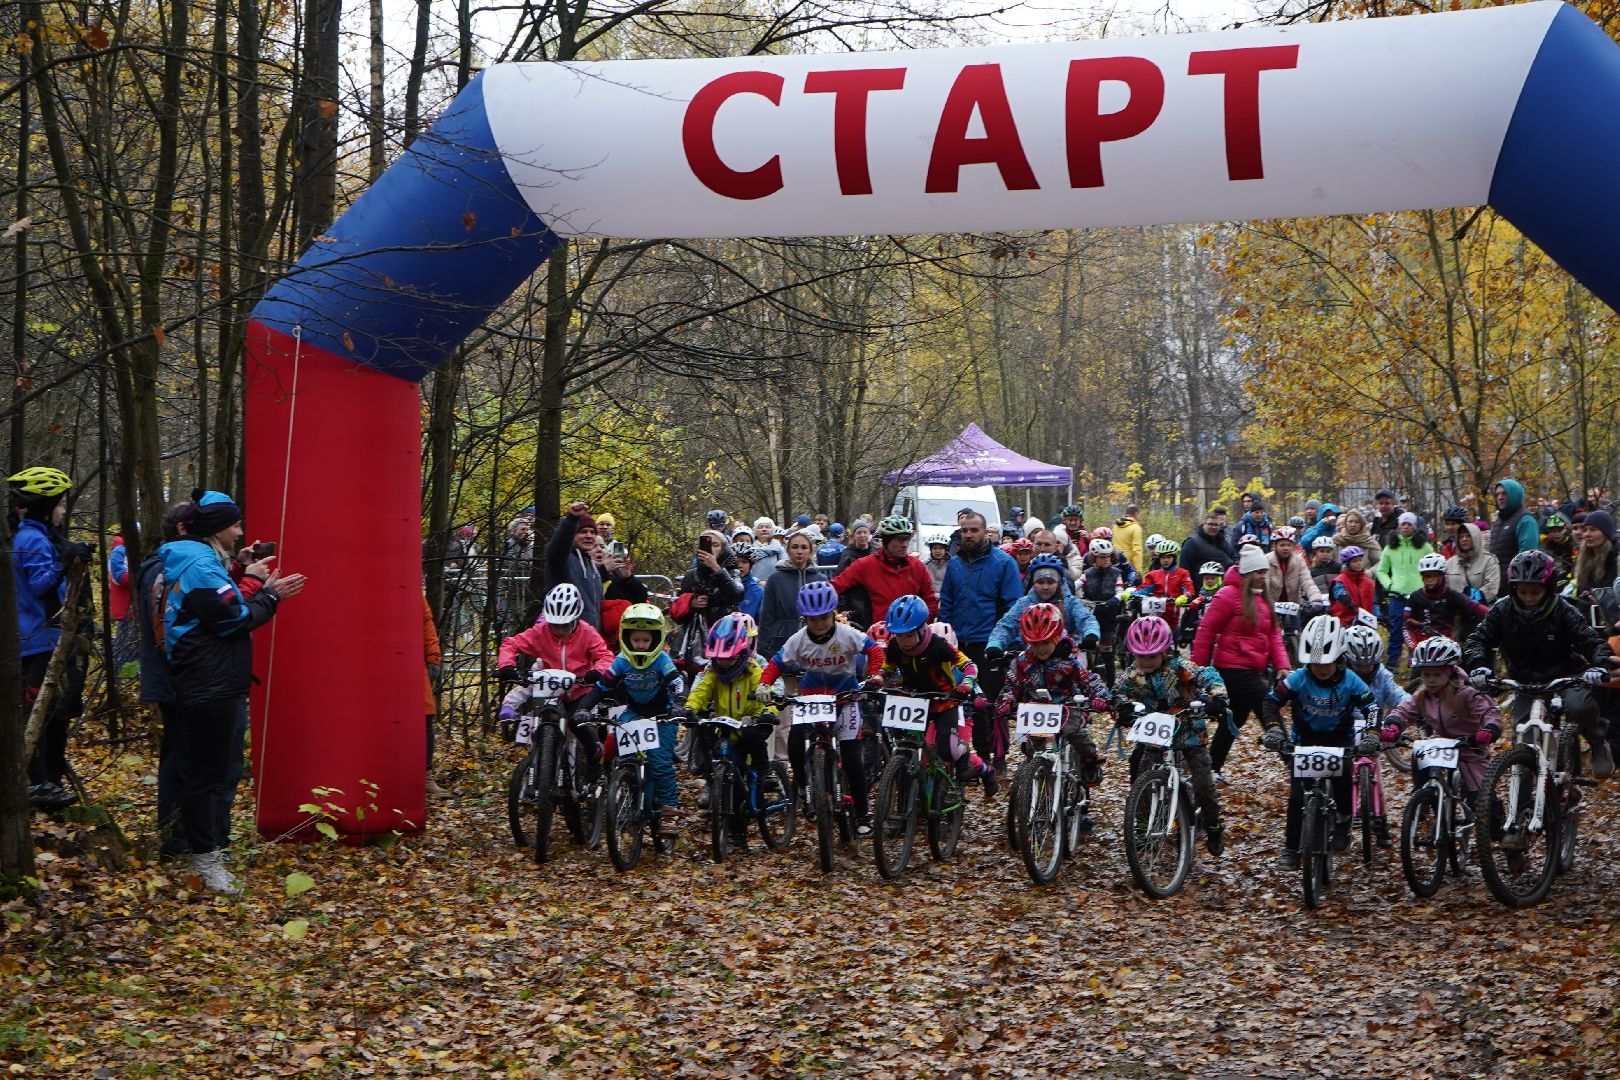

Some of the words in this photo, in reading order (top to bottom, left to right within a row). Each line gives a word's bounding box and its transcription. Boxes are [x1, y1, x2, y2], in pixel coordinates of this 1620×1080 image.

[682, 44, 1300, 200] СТАРТ
[536, 676, 573, 691] 160
[795, 703, 834, 717] 389
[886, 704, 926, 724] 102
[1019, 711, 1060, 727] 195
[619, 727, 656, 747] 416
[1133, 720, 1171, 740] 196
[1296, 754, 1341, 771] 388
